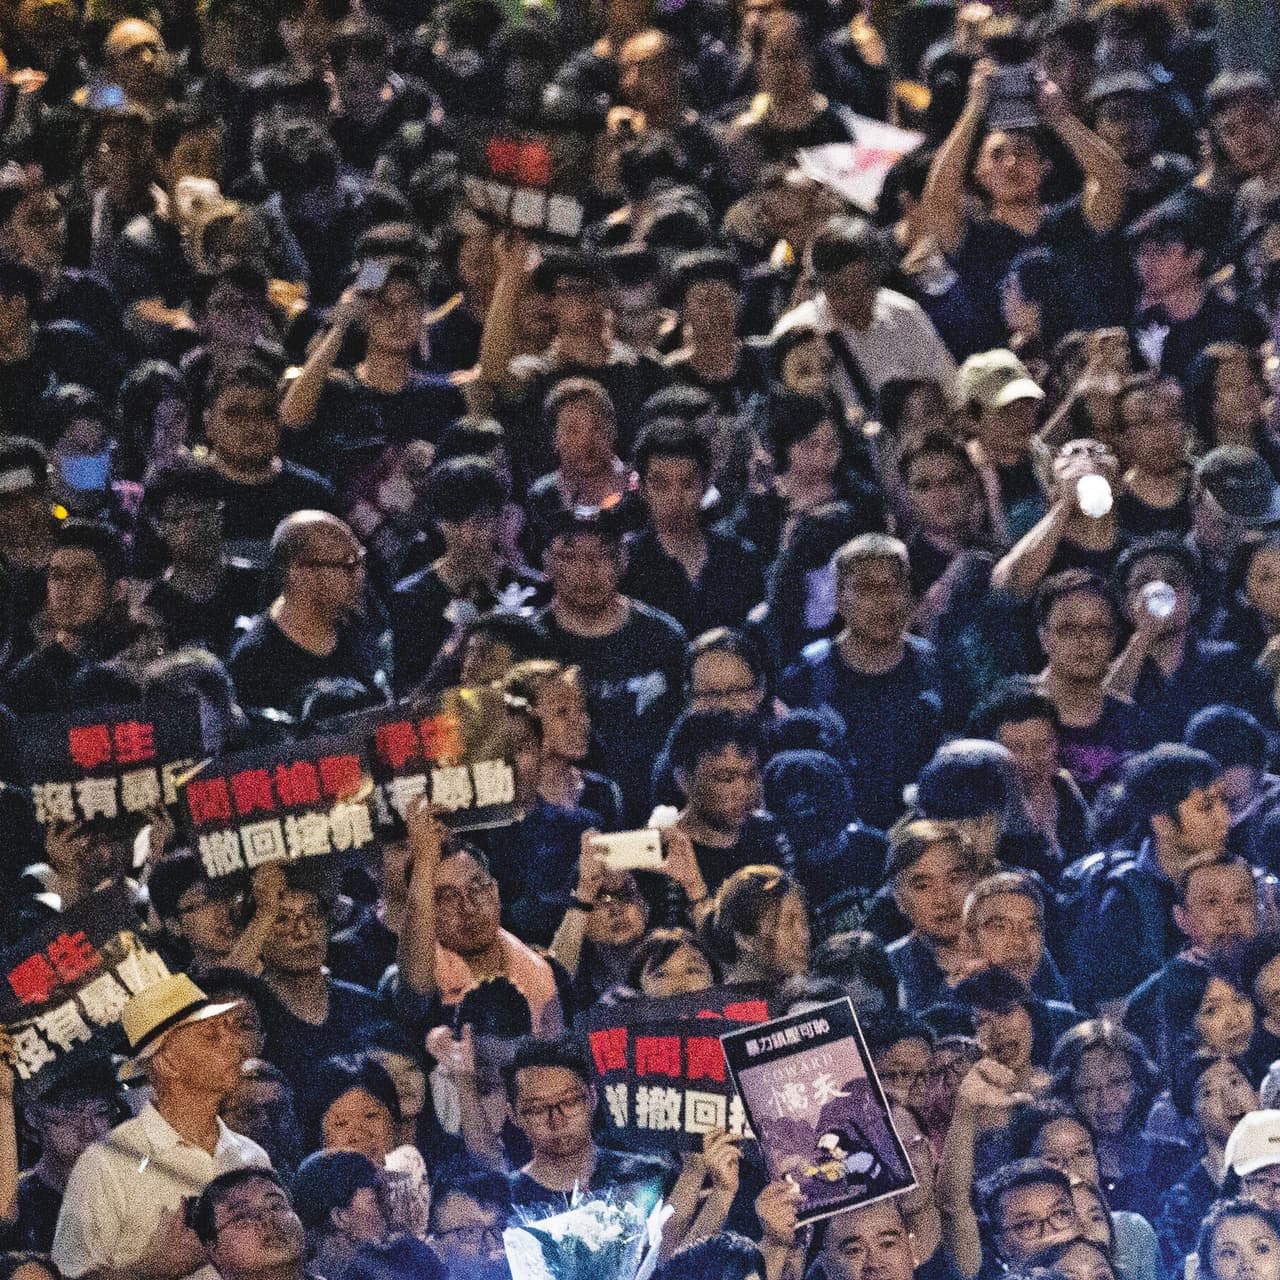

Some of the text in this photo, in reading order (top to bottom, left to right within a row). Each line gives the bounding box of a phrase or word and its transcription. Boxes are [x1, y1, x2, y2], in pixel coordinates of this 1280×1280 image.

[69, 721, 155, 768] 學生
[187, 755, 362, 825] 問責槍擊
[200, 802, 374, 878] 撤回控罪
[8, 931, 102, 1005] 學生
